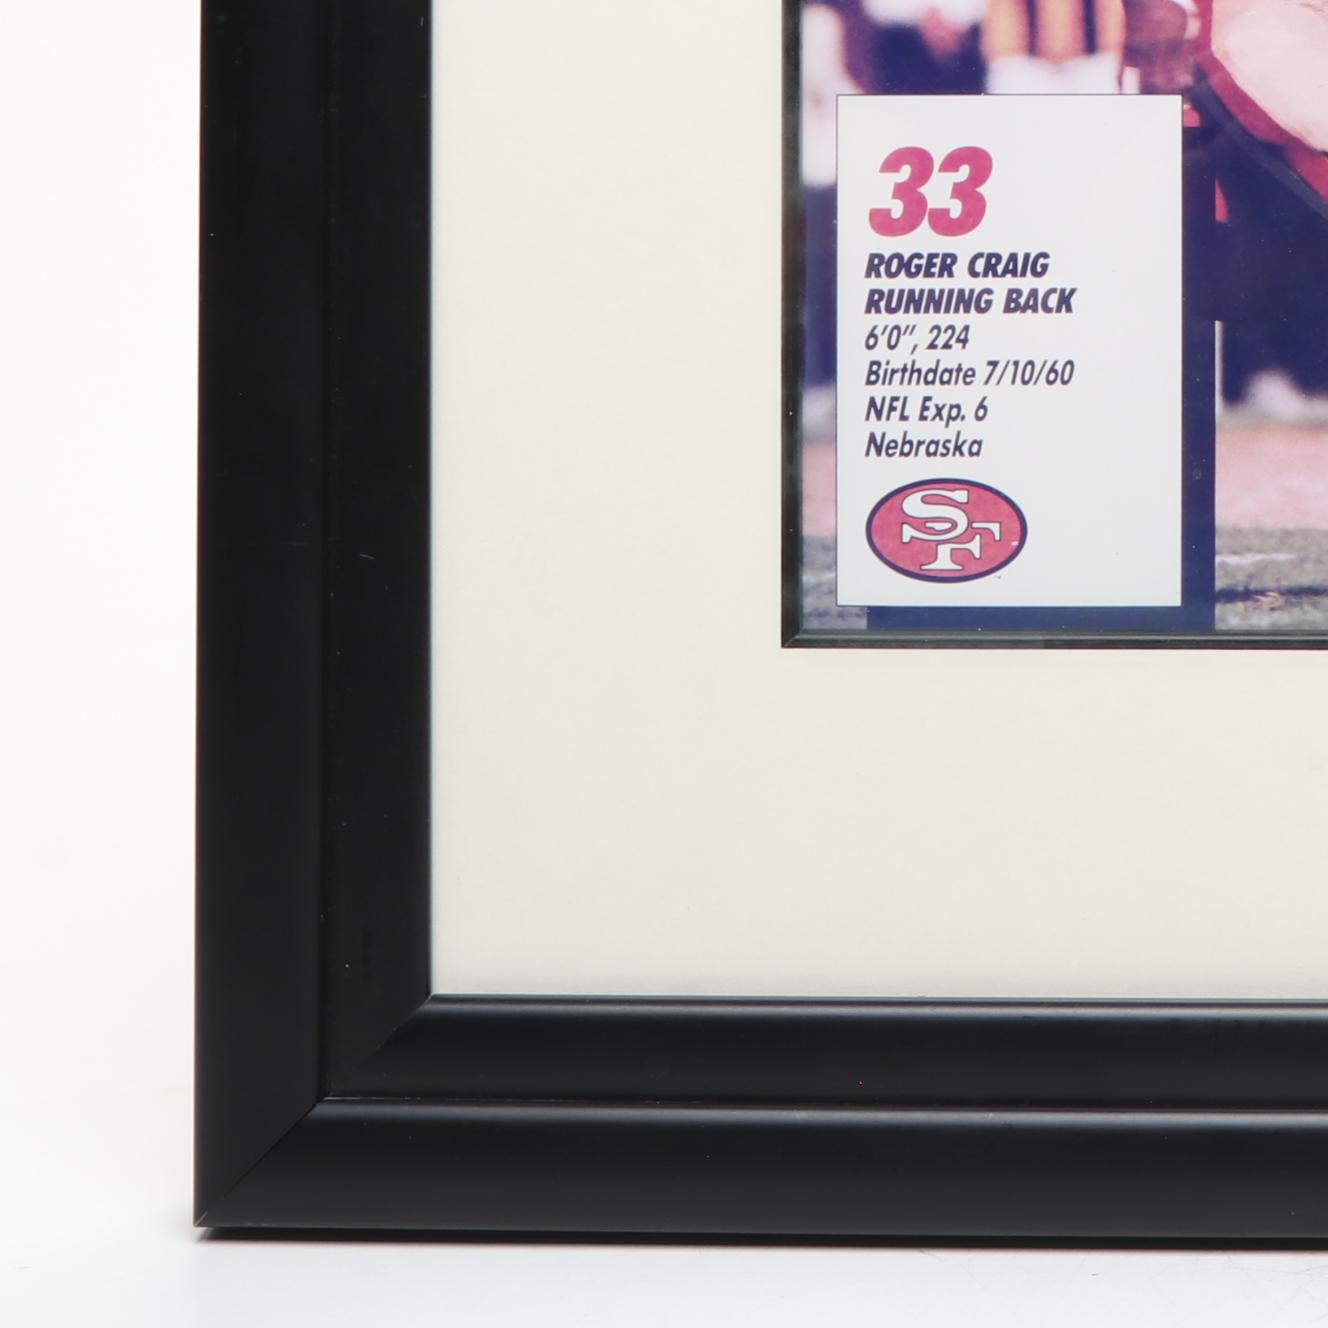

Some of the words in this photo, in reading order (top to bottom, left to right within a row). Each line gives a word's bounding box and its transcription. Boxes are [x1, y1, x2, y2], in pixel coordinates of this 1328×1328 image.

[869, 145, 994, 238] 33
[864, 251, 958, 279] ROGER
[967, 251, 1051, 279] CRAIG
[864, 287, 994, 315] RUNNING
[1003, 287, 1078, 315] BACK
[926, 324, 970, 351] 224
[865, 359, 976, 387] Birthdate
[983, 359, 1075, 386] 7/10/60
[865, 395, 909, 422] NFL
[918, 395, 966, 429] Exp.
[974, 395, 989, 422] 6
[865, 430, 983, 458] Nebraska
[901, 488, 1001, 571] SF
